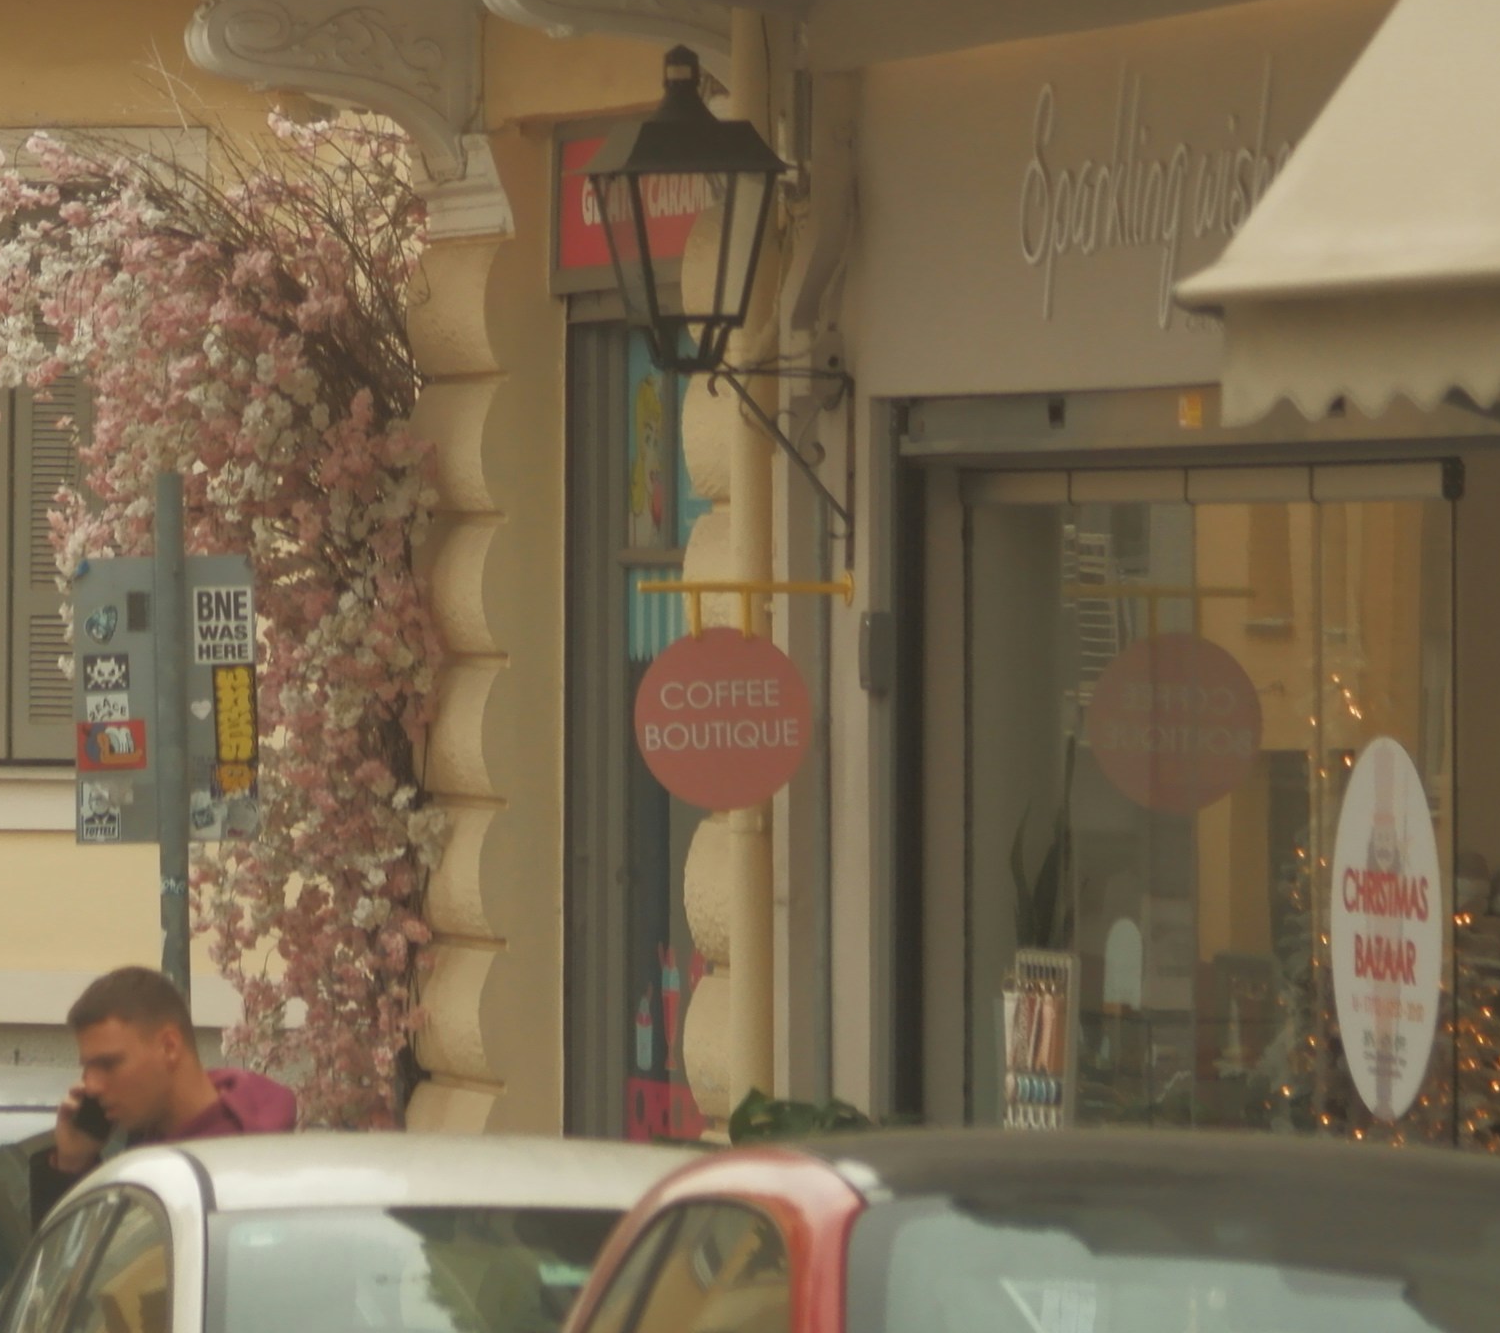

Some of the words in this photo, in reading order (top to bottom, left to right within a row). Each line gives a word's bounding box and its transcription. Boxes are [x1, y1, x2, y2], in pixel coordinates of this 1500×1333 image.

[1020, 58, 1189, 330] Sparkling
[1193, 55, 1295, 239] wish
[196, 591, 248, 622] BNE
[197, 623, 249, 641] WAS
[198, 642, 249, 661] HERE
[659, 679, 779, 710] COFFEE
[644, 718, 800, 752] BOUTIQUE
[1342, 867, 1430, 922] CHRISTMAS
[1354, 934, 1417, 985] BAZAAR
